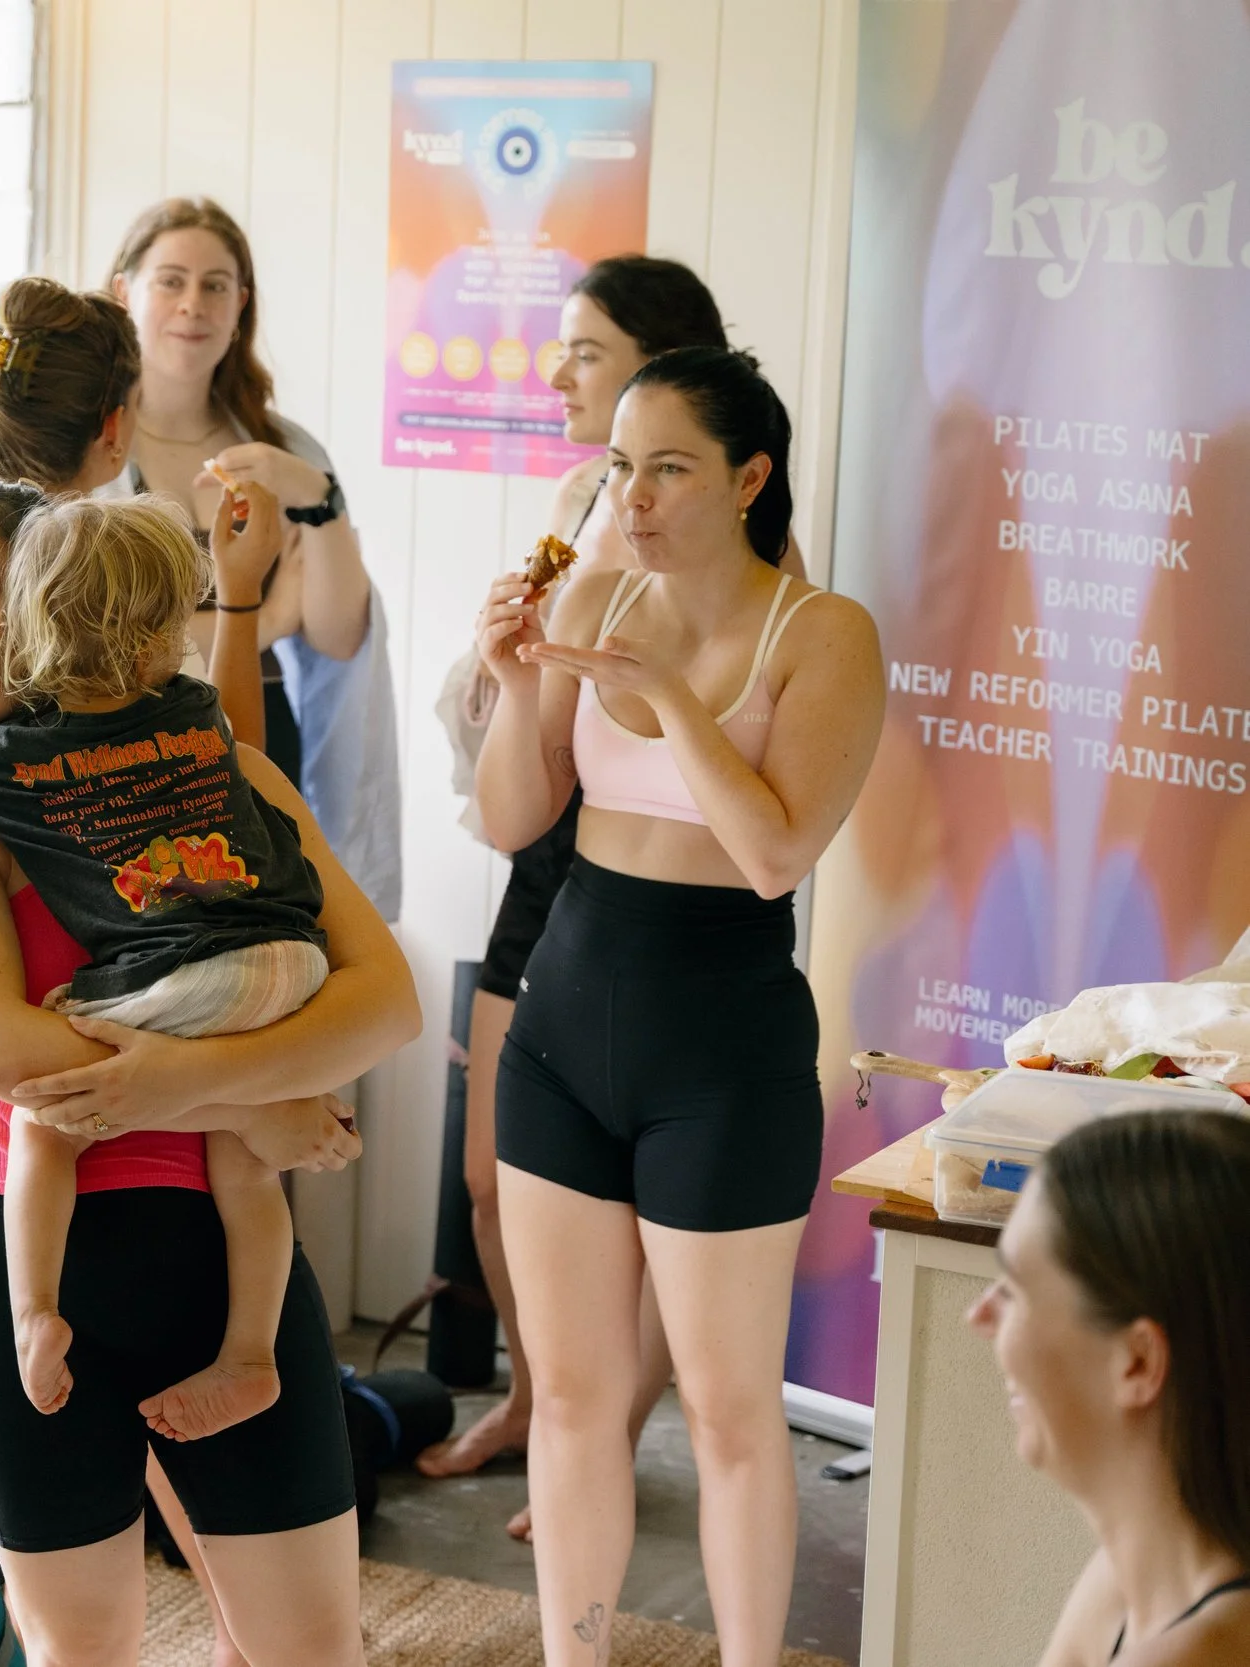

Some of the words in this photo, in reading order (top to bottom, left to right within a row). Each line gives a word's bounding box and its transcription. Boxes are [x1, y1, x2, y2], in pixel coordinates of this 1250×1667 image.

[1050, 97, 1168, 186] be
[995, 415, 1128, 456] PILATES
[1147, 429, 1210, 463] MAT
[1002, 468, 1078, 504] YOGA
[1098, 479, 1193, 517] ASANA
[999, 519, 1191, 571] BREATHWORK
[1045, 577, 1137, 617] BARRE
[1013, 625, 1069, 661] YIN
[1090, 635, 1162, 675] YOGA
[890, 661, 951, 697] NEW
[970, 671, 1123, 722] REFORMER
[64, 739, 160, 780] Wellness
[919, 715, 1052, 763] TEACHER
[1074, 738, 1247, 795] TRAININGS
[43, 806, 76, 825] Relax
[79, 798, 105, 821] your
[132, 772, 172, 796] Pilates
[93, 802, 177, 830] Sustainability
[182, 788, 229, 813] Kyndness
[89, 836, 121, 855] Prana
[169, 817, 210, 836] Contrology
[918, 976, 990, 1012] LEARN
